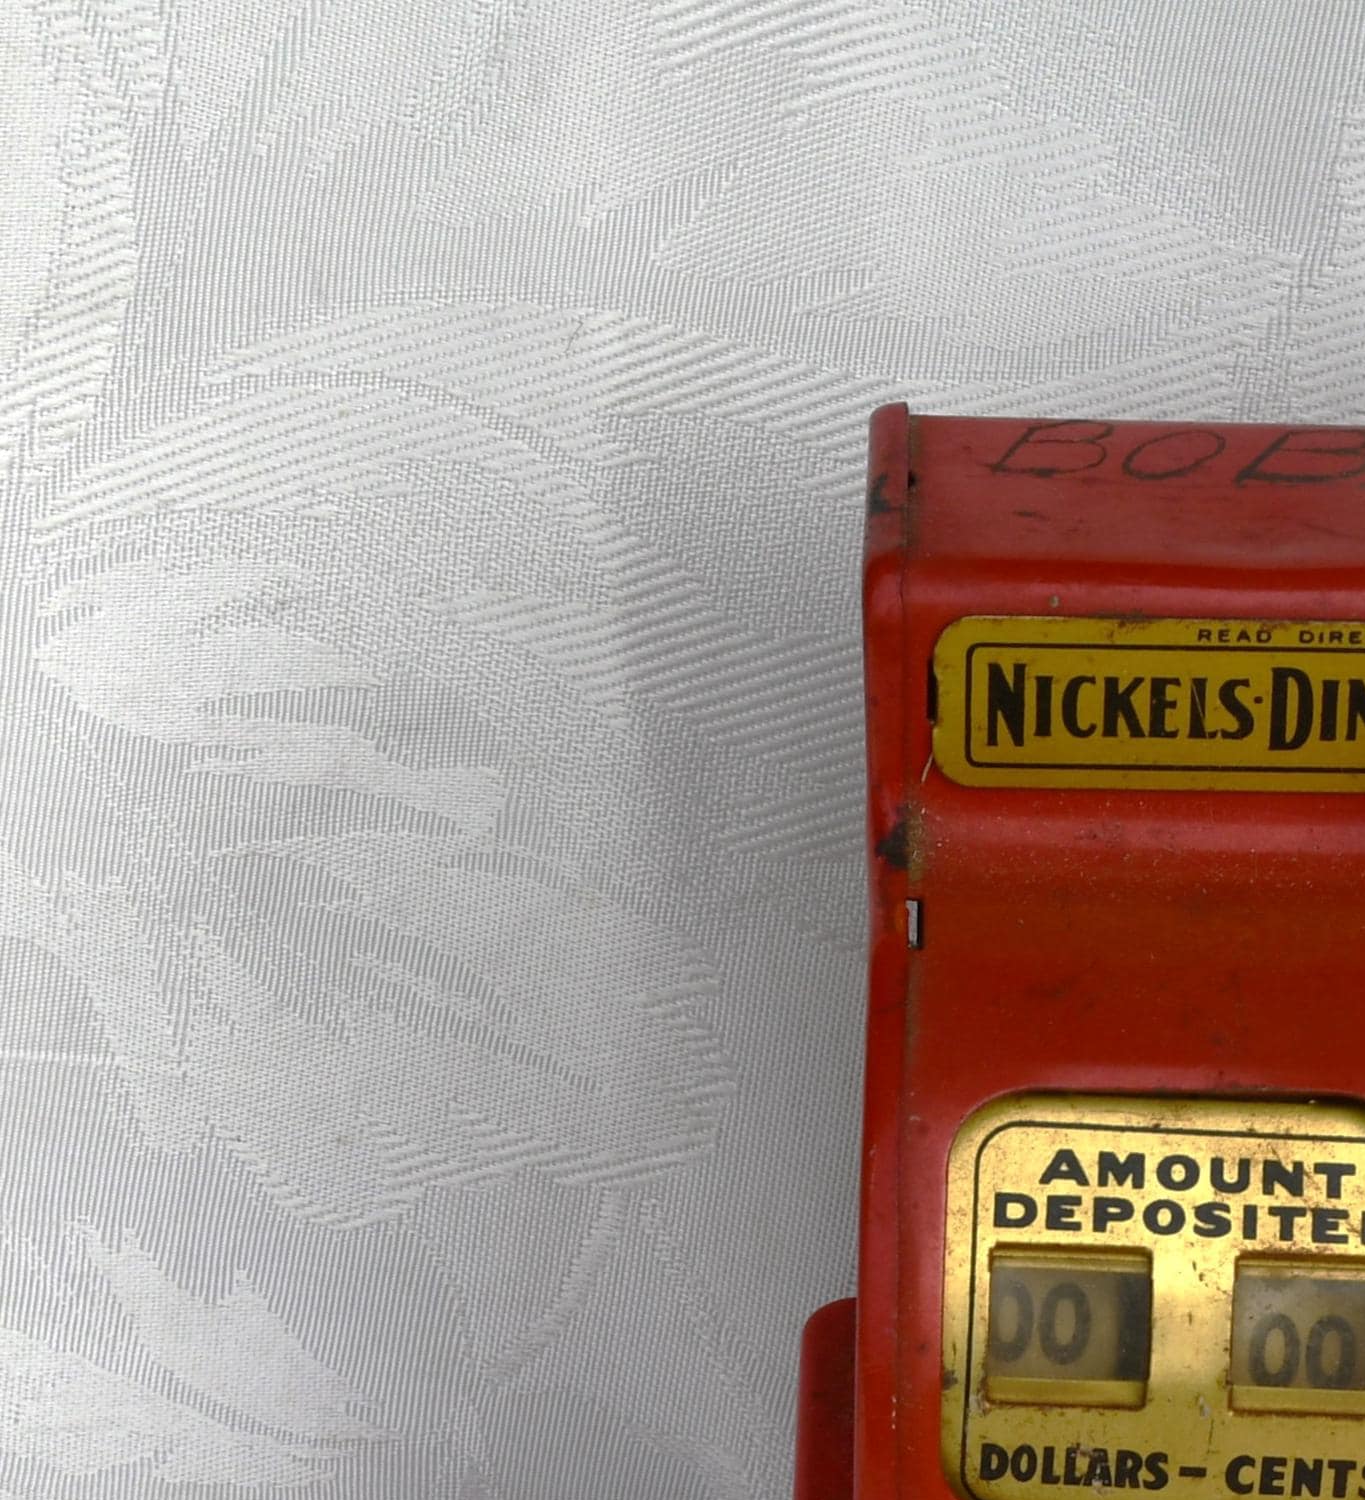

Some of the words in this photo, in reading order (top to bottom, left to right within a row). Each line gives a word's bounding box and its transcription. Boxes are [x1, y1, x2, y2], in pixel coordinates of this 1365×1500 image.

[1198, 629, 1273, 644] READ
[1039, 1148, 1357, 1199] AMOUNT
[1247, 1312, 1358, 1387] 00
[979, 1443, 1169, 1490] DOLLARS
